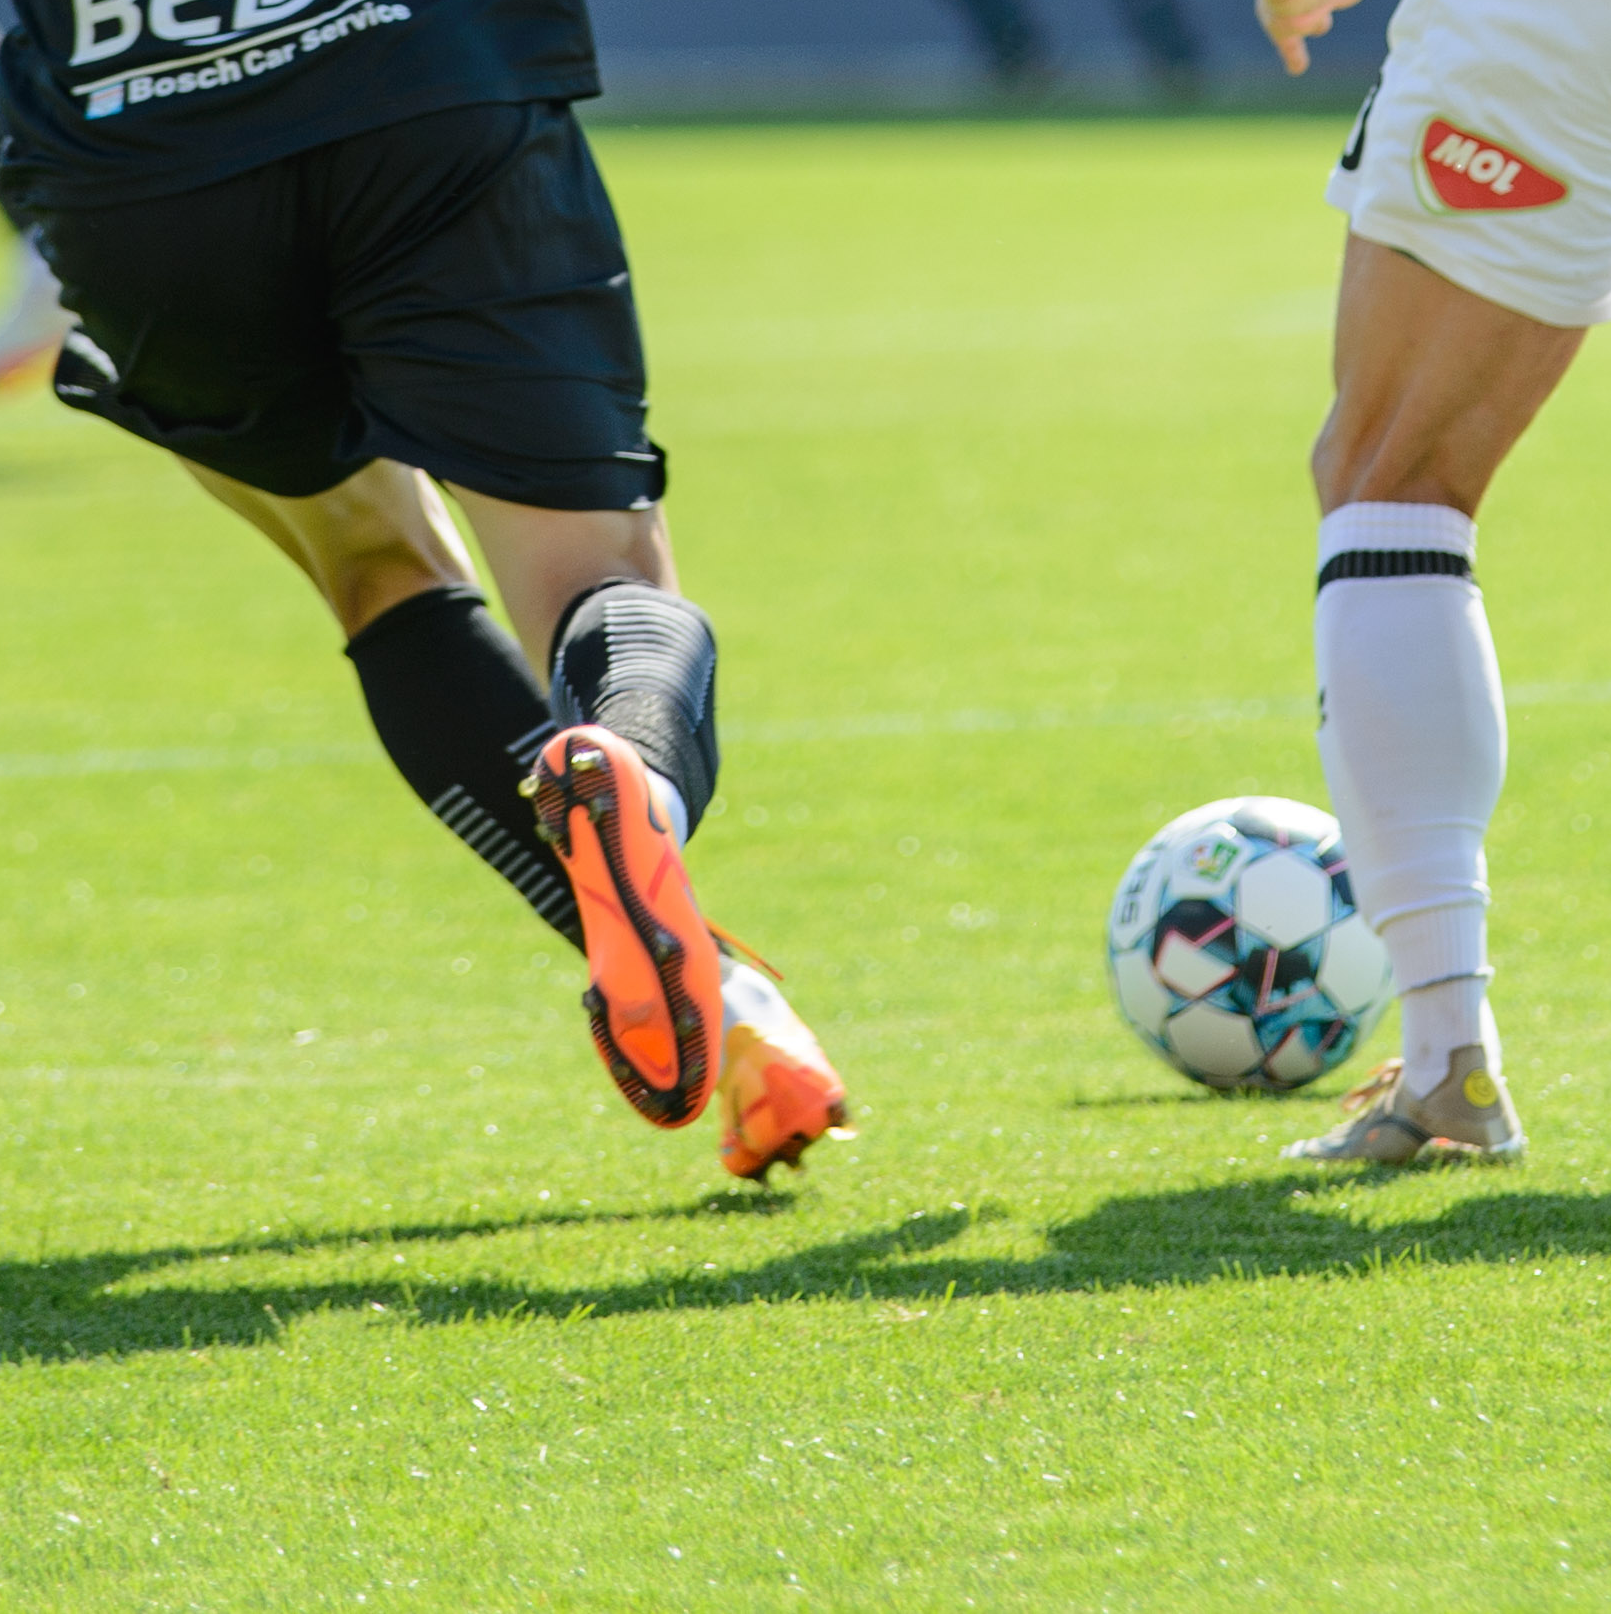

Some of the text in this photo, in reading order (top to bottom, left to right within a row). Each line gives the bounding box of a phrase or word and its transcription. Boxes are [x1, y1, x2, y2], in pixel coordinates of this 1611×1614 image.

[126, 2, 413, 105] Bosch Car Service
[1429, 132, 1523, 196] MOL
